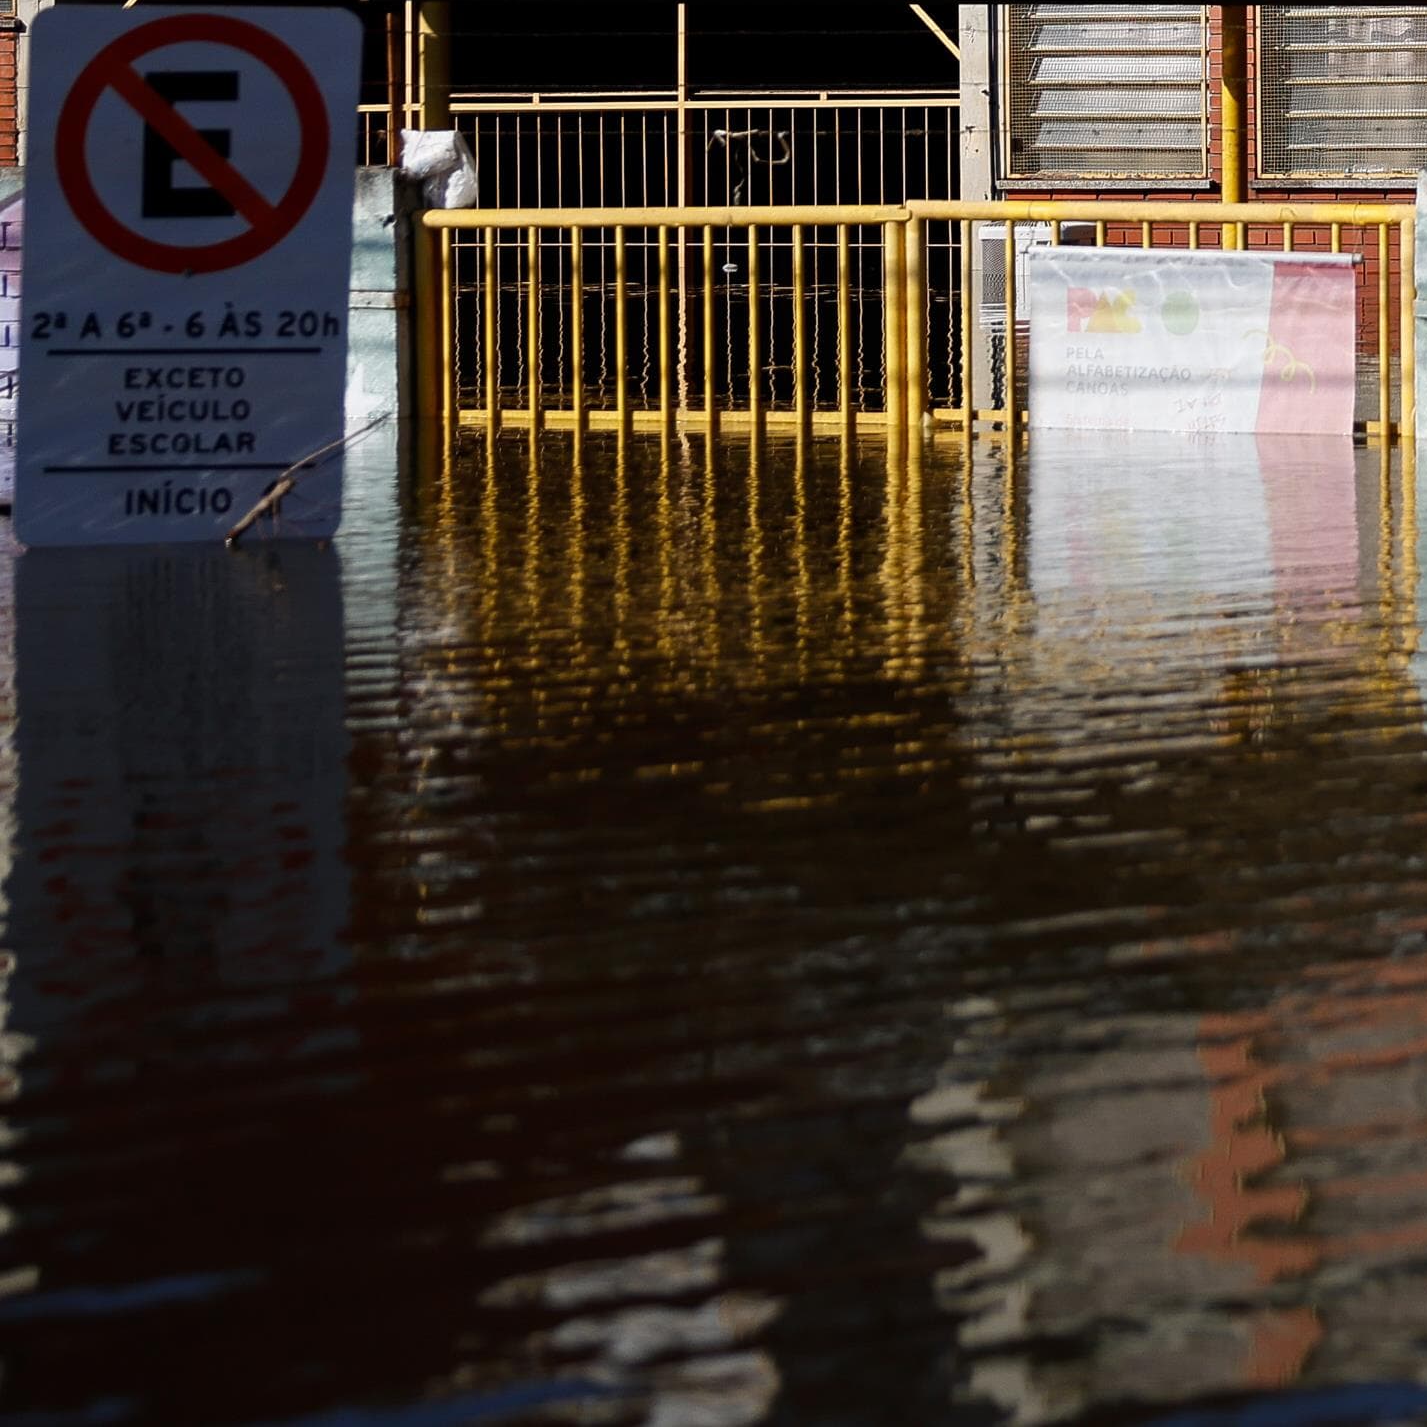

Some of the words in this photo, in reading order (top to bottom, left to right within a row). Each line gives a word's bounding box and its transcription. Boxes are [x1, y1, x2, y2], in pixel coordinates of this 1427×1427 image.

[80, 311, 102, 338] A
[186, 311, 205, 338] 6
[218, 302, 262, 338] ÀS
[277, 309, 340, 338] 20h
[1066, 347, 1104, 360] PELA
[124, 366, 245, 389] EXCETO
[1066, 364, 1192, 383] ALFABETIZAÇÃO
[1065, 381, 1129, 396] CANOAS
[115, 394, 251, 421] VEÍCULO
[107, 431, 256, 456] ESCOLAR
[125, 479, 233, 516] INÍCIO
